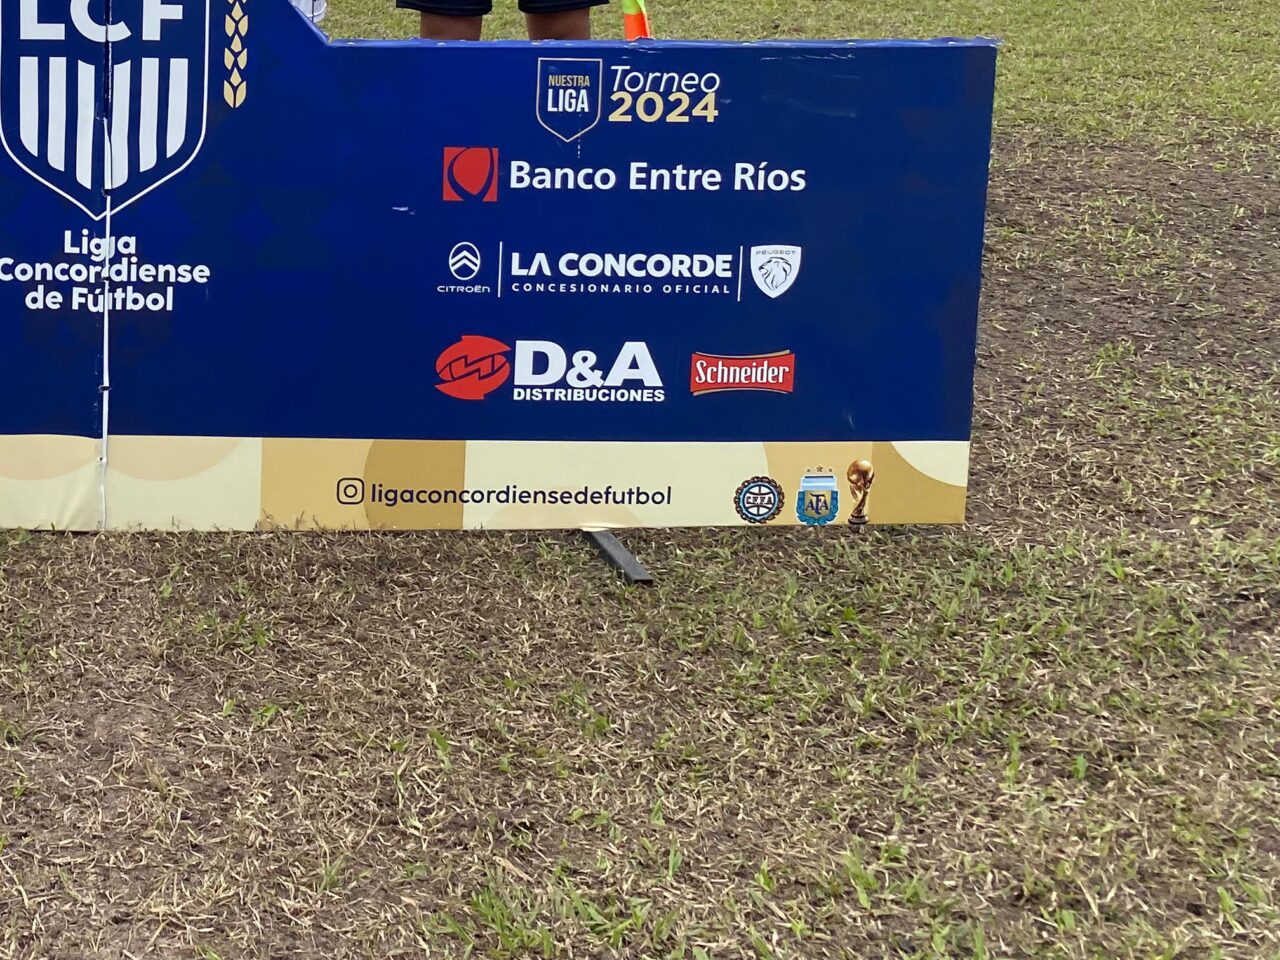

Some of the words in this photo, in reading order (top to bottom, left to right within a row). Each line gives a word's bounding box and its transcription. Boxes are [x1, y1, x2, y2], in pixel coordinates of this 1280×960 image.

[548, 74, 590, 87] NUESTRA
[610, 65, 720, 93] Torneo
[547, 88, 589, 112] LIGA
[608, 91, 719, 123] 2024
[510, 161, 616, 190] Banco
[629, 162, 721, 191] Entre
[734, 161, 806, 191] Ríos
[64, 229, 136, 262] Liga
[511, 252, 551, 276] LA
[558, 252, 732, 278] CONCORDE
[25, 284, 63, 310] de
[71, 286, 174, 313] Fútbol
[511, 283, 652, 294] CONCESIONARIO
[662, 283, 730, 294] OFICIAL
[514, 339, 663, 389] D&A
[694, 360, 789, 384] Schneider
[513, 388, 665, 402] DISTRIBUCIONES
[371, 483, 672, 507] ligaconcordiensedefutbol
[805, 492, 829, 515] AFA
